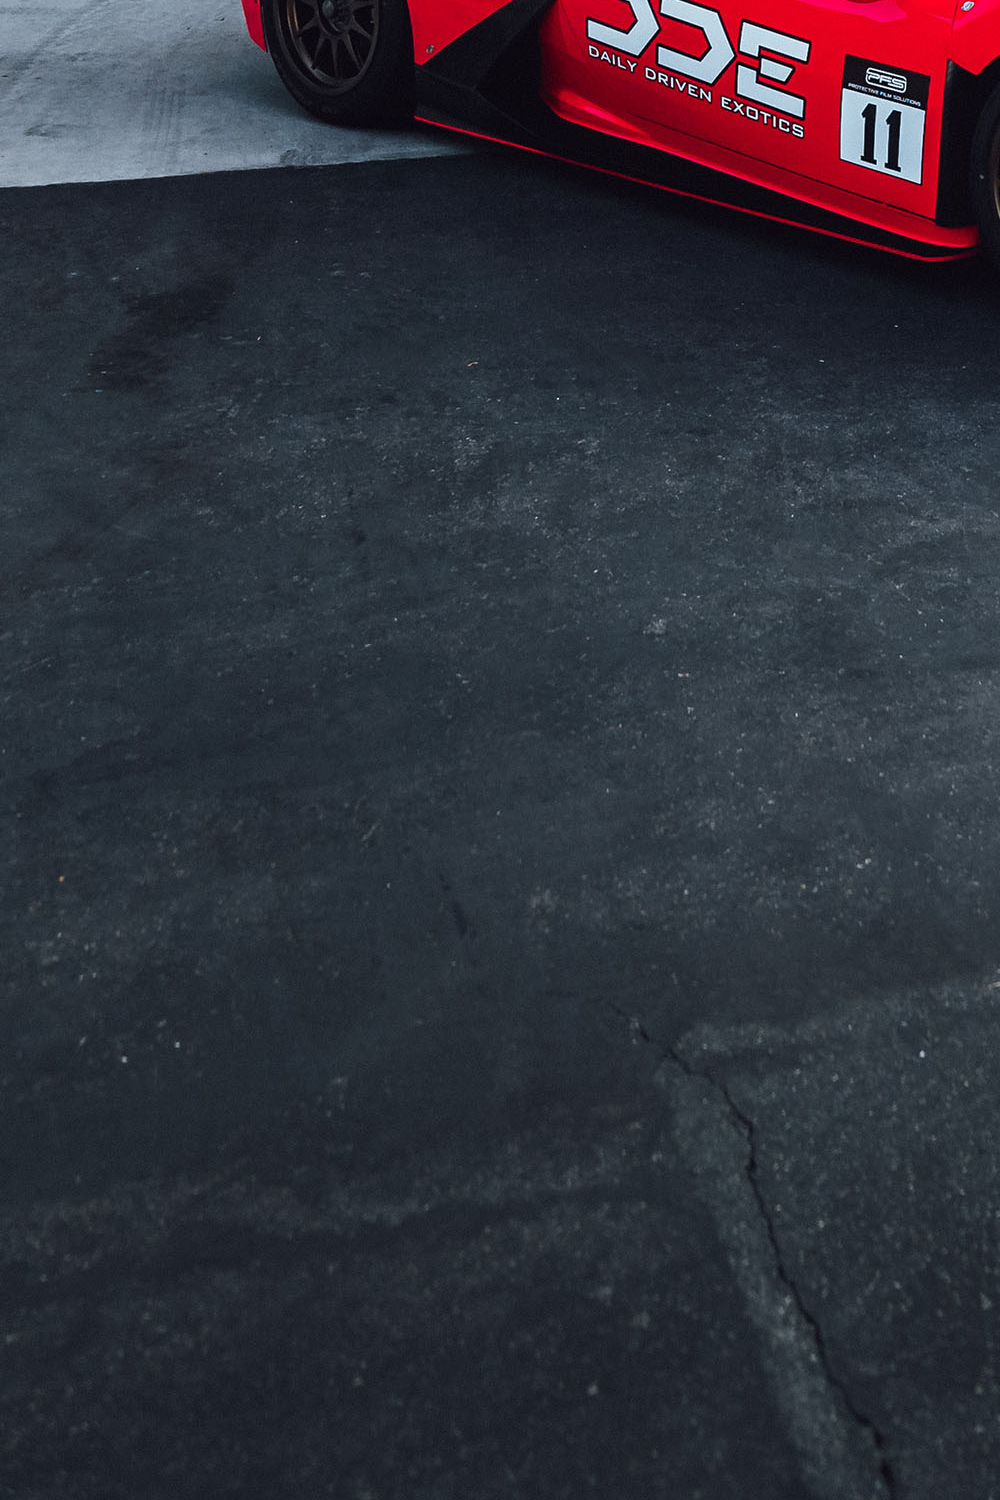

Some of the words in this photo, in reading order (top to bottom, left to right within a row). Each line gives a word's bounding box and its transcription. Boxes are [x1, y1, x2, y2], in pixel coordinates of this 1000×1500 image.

[588, 45, 637, 73] DAILY
[645, 67, 712, 103] DRIVEN
[721, 96, 804, 138] EXOTICS
[879, 91, 892, 99] FILM
[892, 94, 921, 107] SOLUTIONS
[861, 103, 902, 172] 11
